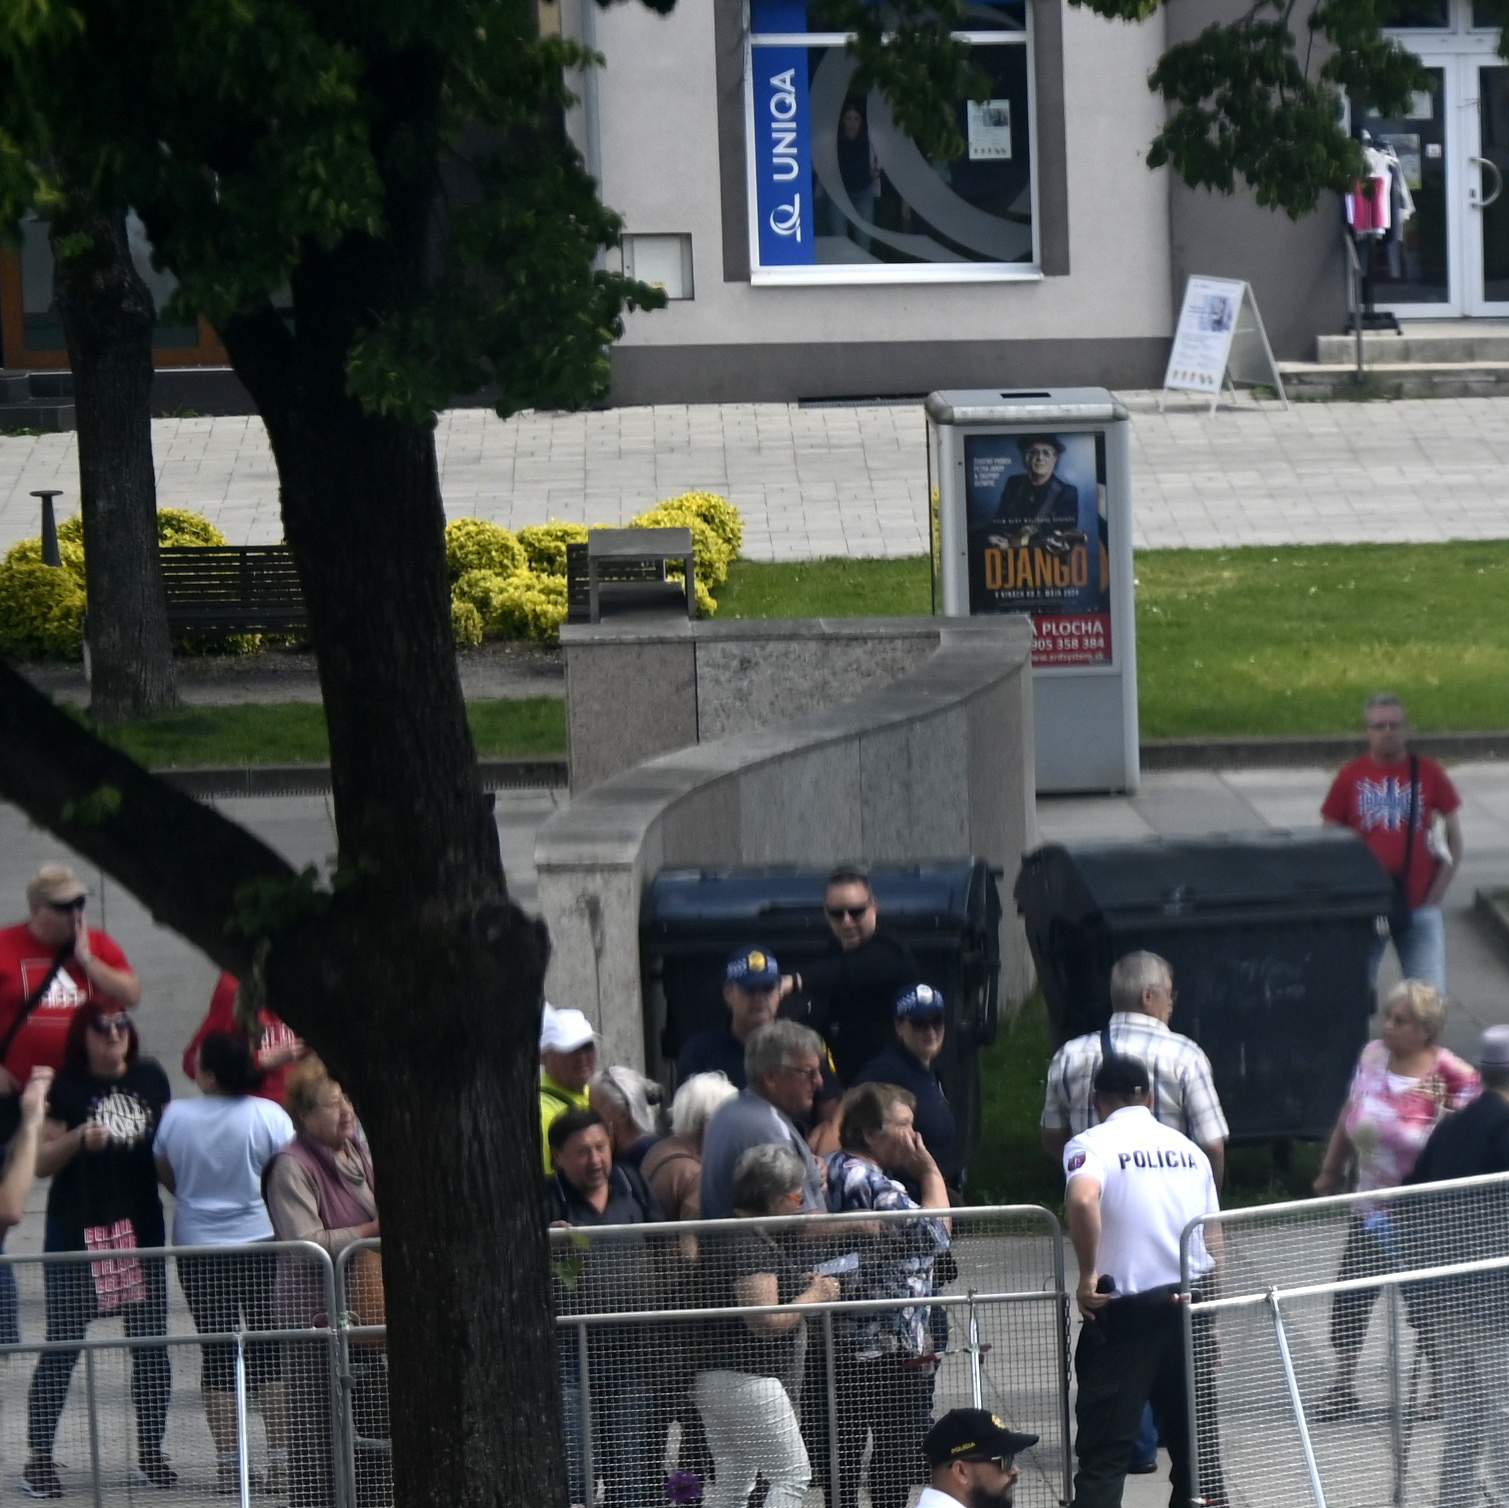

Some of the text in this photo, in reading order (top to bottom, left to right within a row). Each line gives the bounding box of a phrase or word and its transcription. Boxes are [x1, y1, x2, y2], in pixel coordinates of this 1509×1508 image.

[769, 68, 799, 181] UNIQA
[985, 545, 1088, 590] DJANGO
[1042, 621, 1103, 637] PLOCHA
[1058, 638, 1078, 650] 358
[1083, 636, 1104, 649] 384
[1118, 1147, 1198, 1169] POLÍCIA
